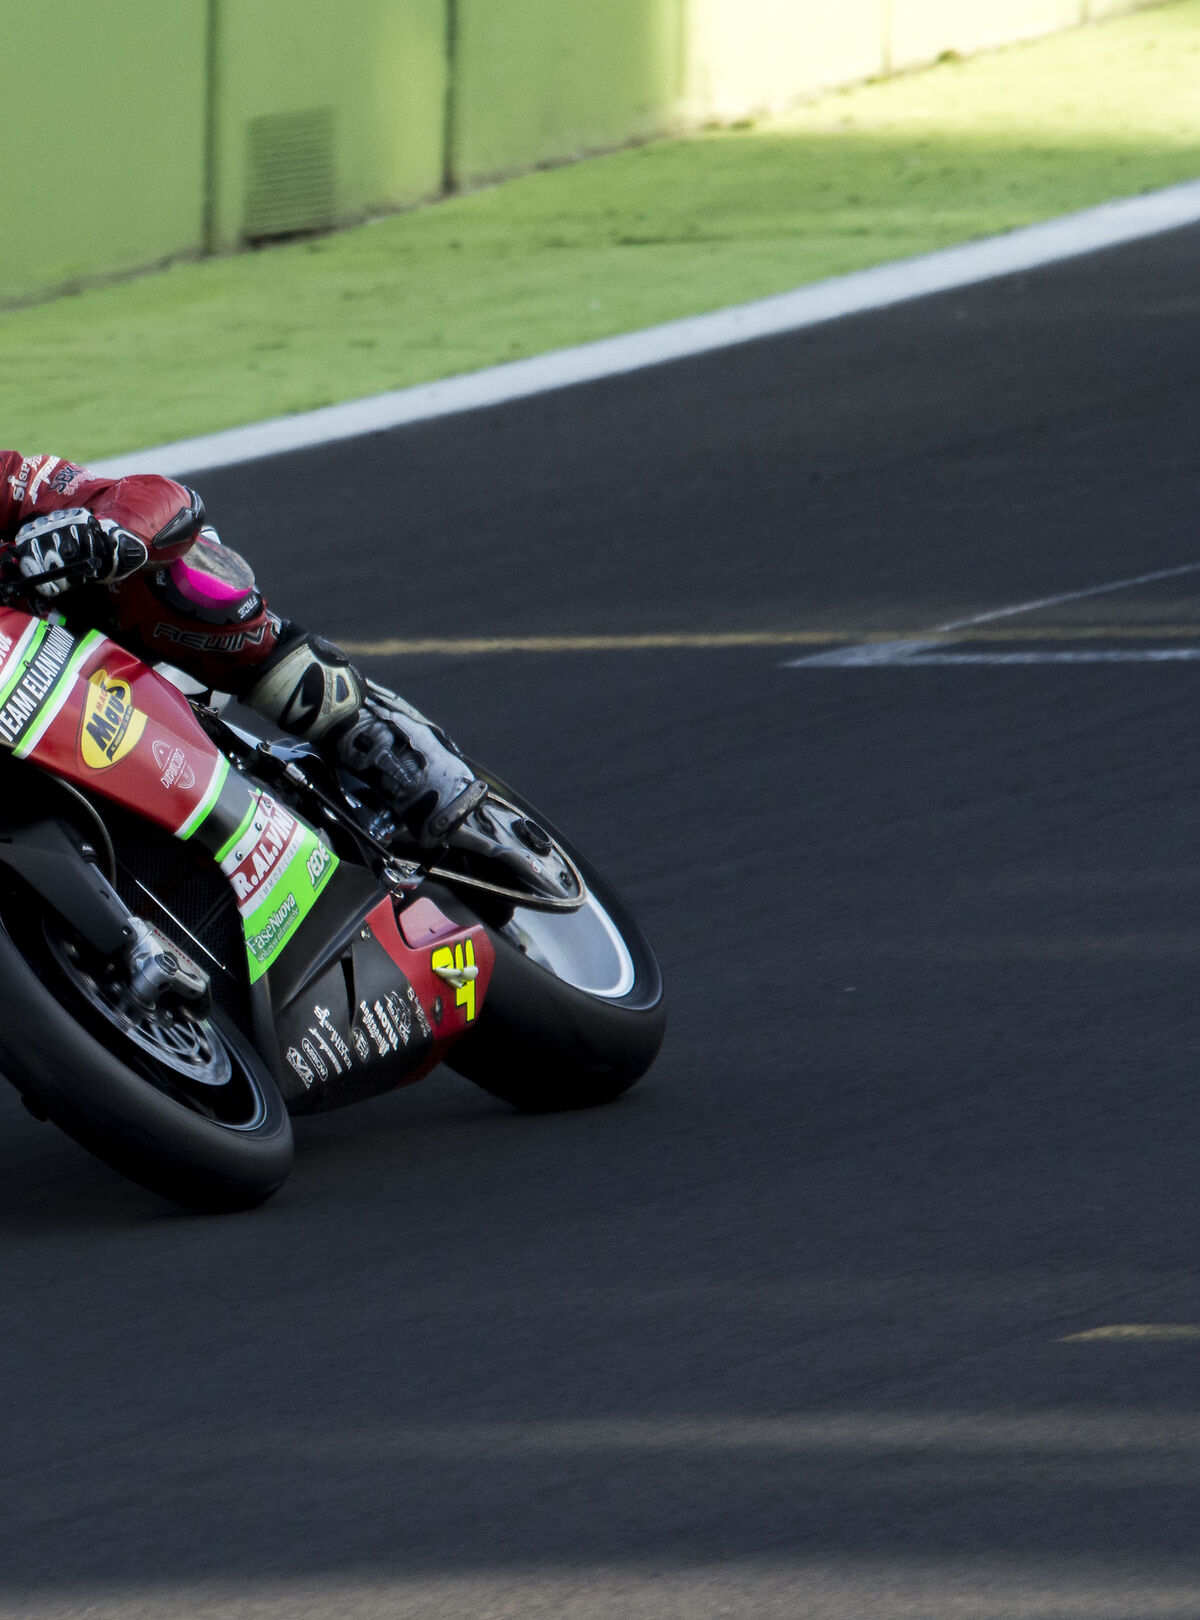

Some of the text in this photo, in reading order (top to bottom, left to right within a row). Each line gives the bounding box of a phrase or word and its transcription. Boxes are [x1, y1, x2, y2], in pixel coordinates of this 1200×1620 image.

[153, 621, 266, 652] REWIN
[21, 652, 61, 700] ELLAN
[373, 999, 400, 1051] MOTUL
